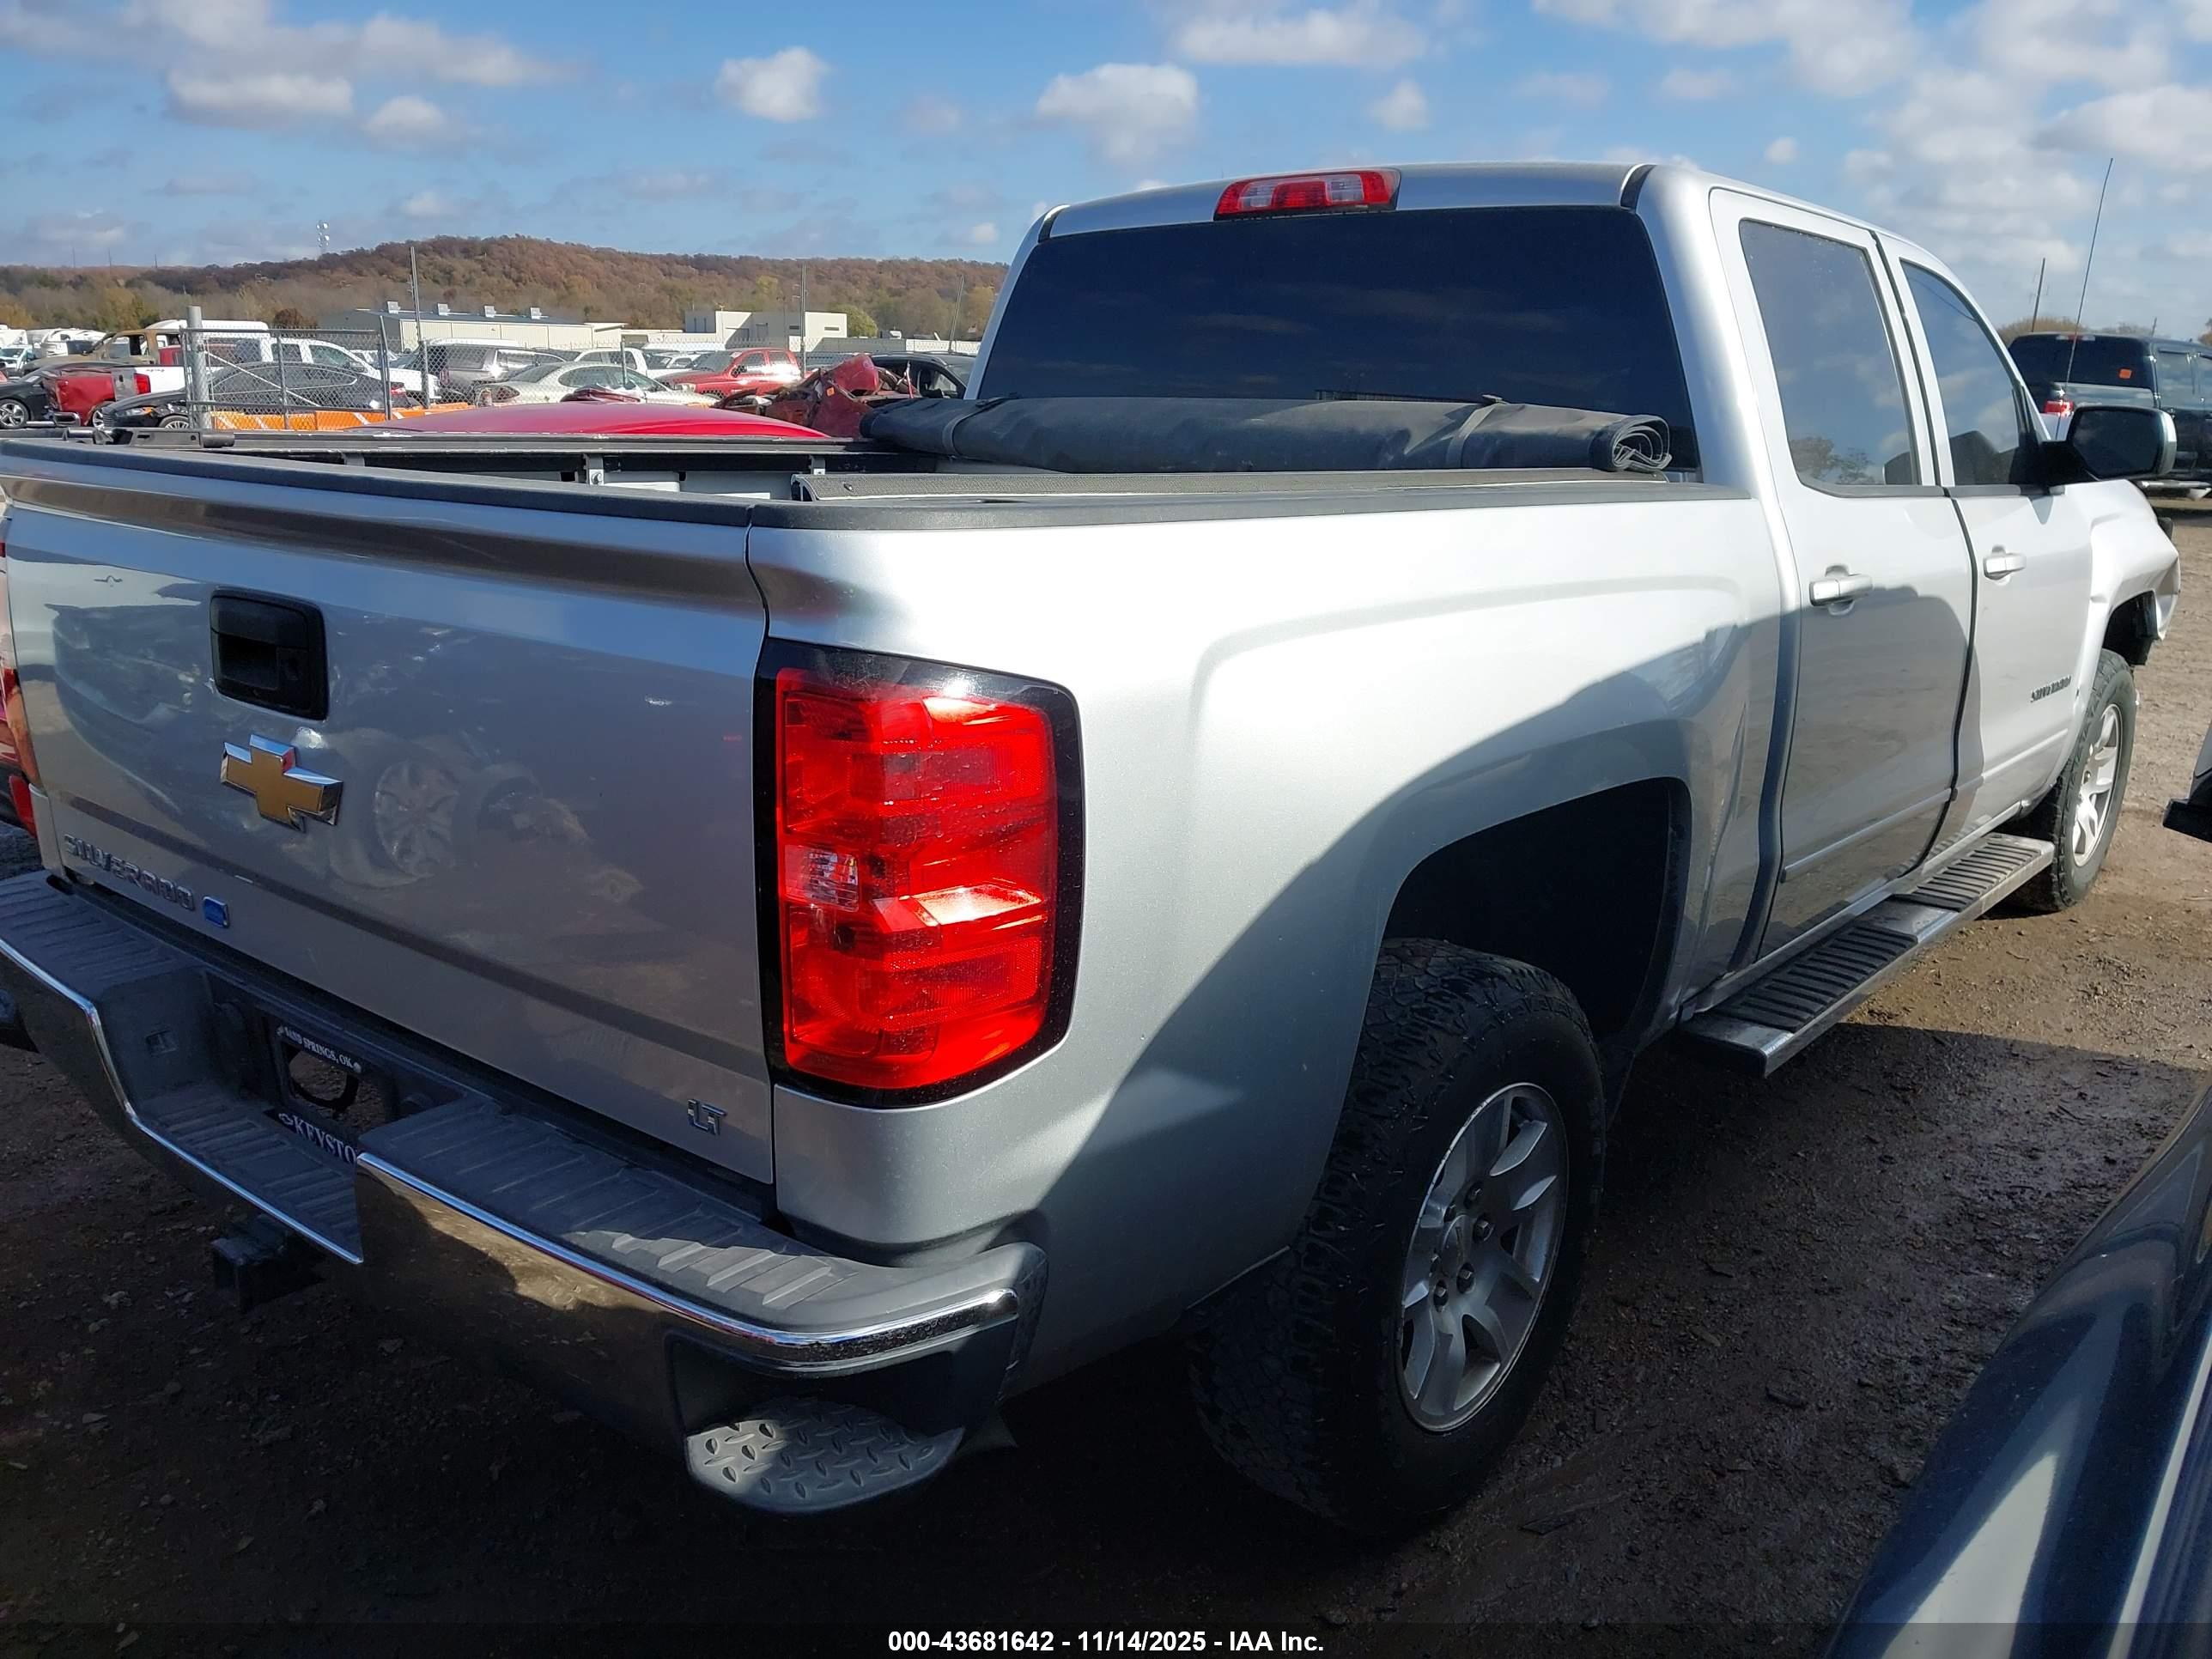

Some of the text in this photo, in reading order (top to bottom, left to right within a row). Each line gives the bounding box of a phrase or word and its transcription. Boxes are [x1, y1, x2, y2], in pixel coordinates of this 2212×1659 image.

[302, 1036, 340, 1065] SPRINGS,
[339, 1055, 355, 1069] OK
[686, 1098, 727, 1136] LT
[292, 1114, 358, 1165] KEYSTO
